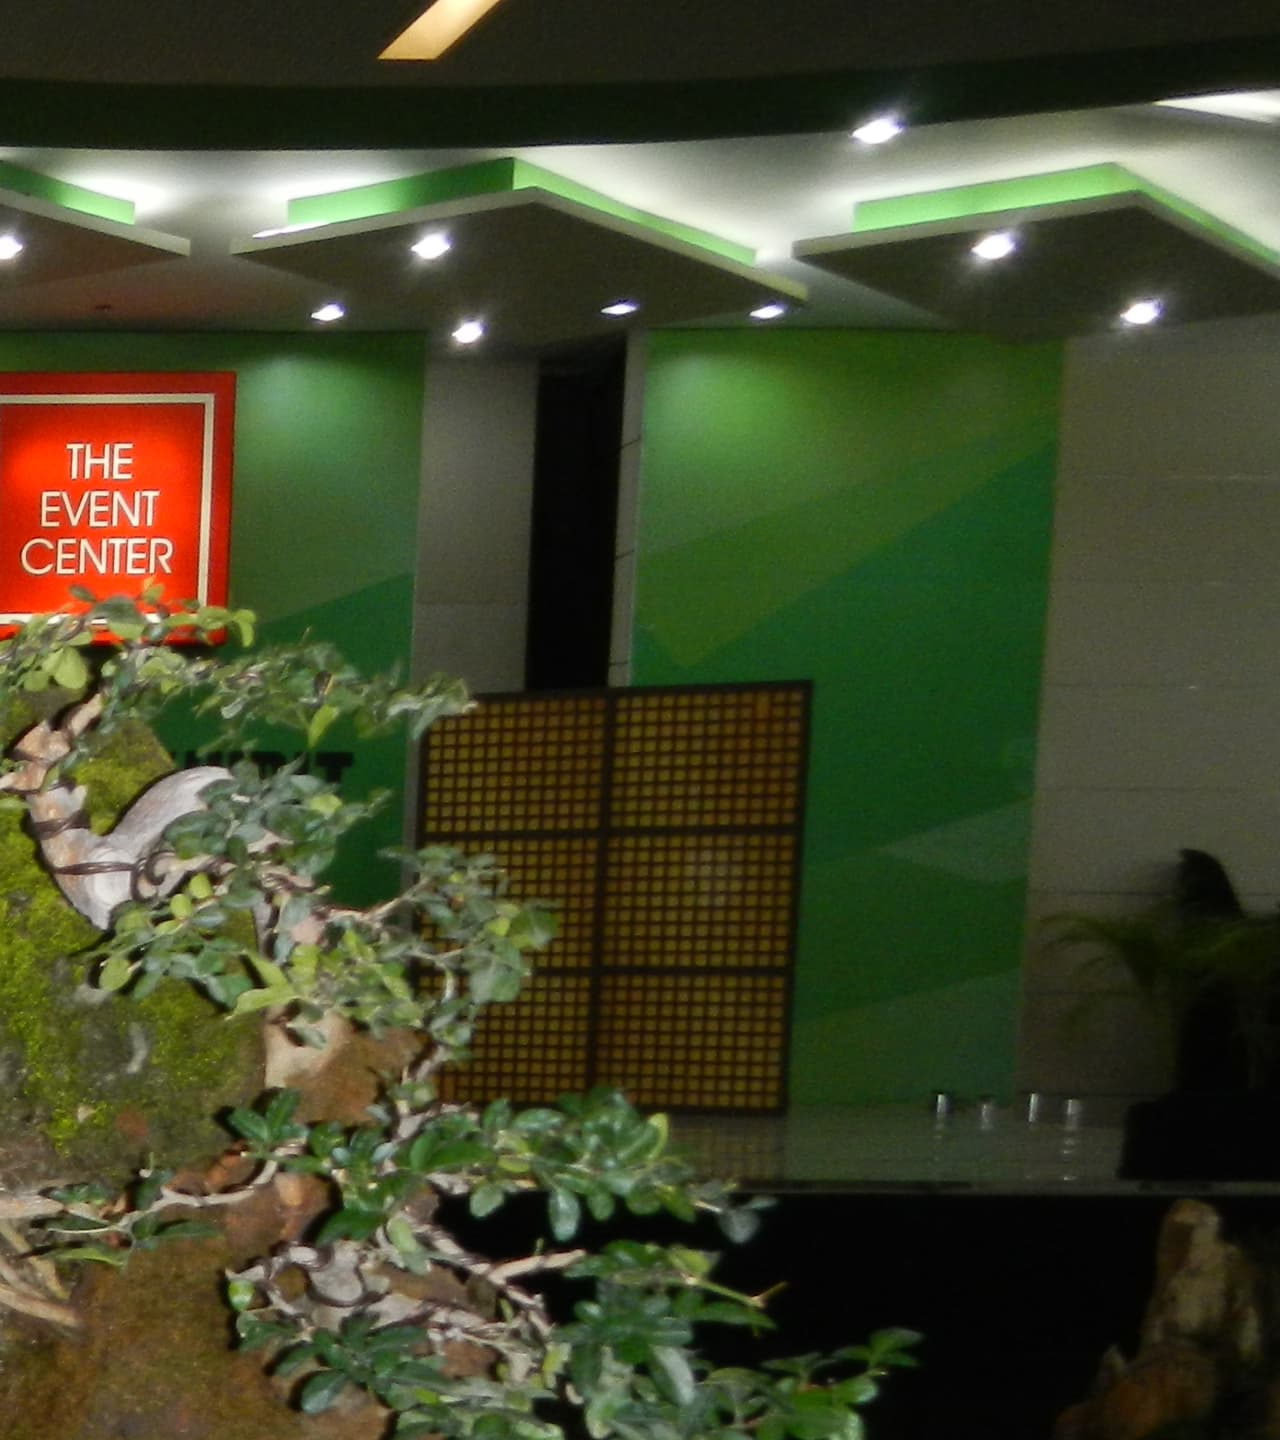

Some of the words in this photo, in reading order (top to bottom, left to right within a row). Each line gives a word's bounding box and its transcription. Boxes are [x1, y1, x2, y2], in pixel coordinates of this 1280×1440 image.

[65, 442, 134, 480] THE
[40, 490, 160, 528] EVENT
[20, 537, 174, 575] CENTER
